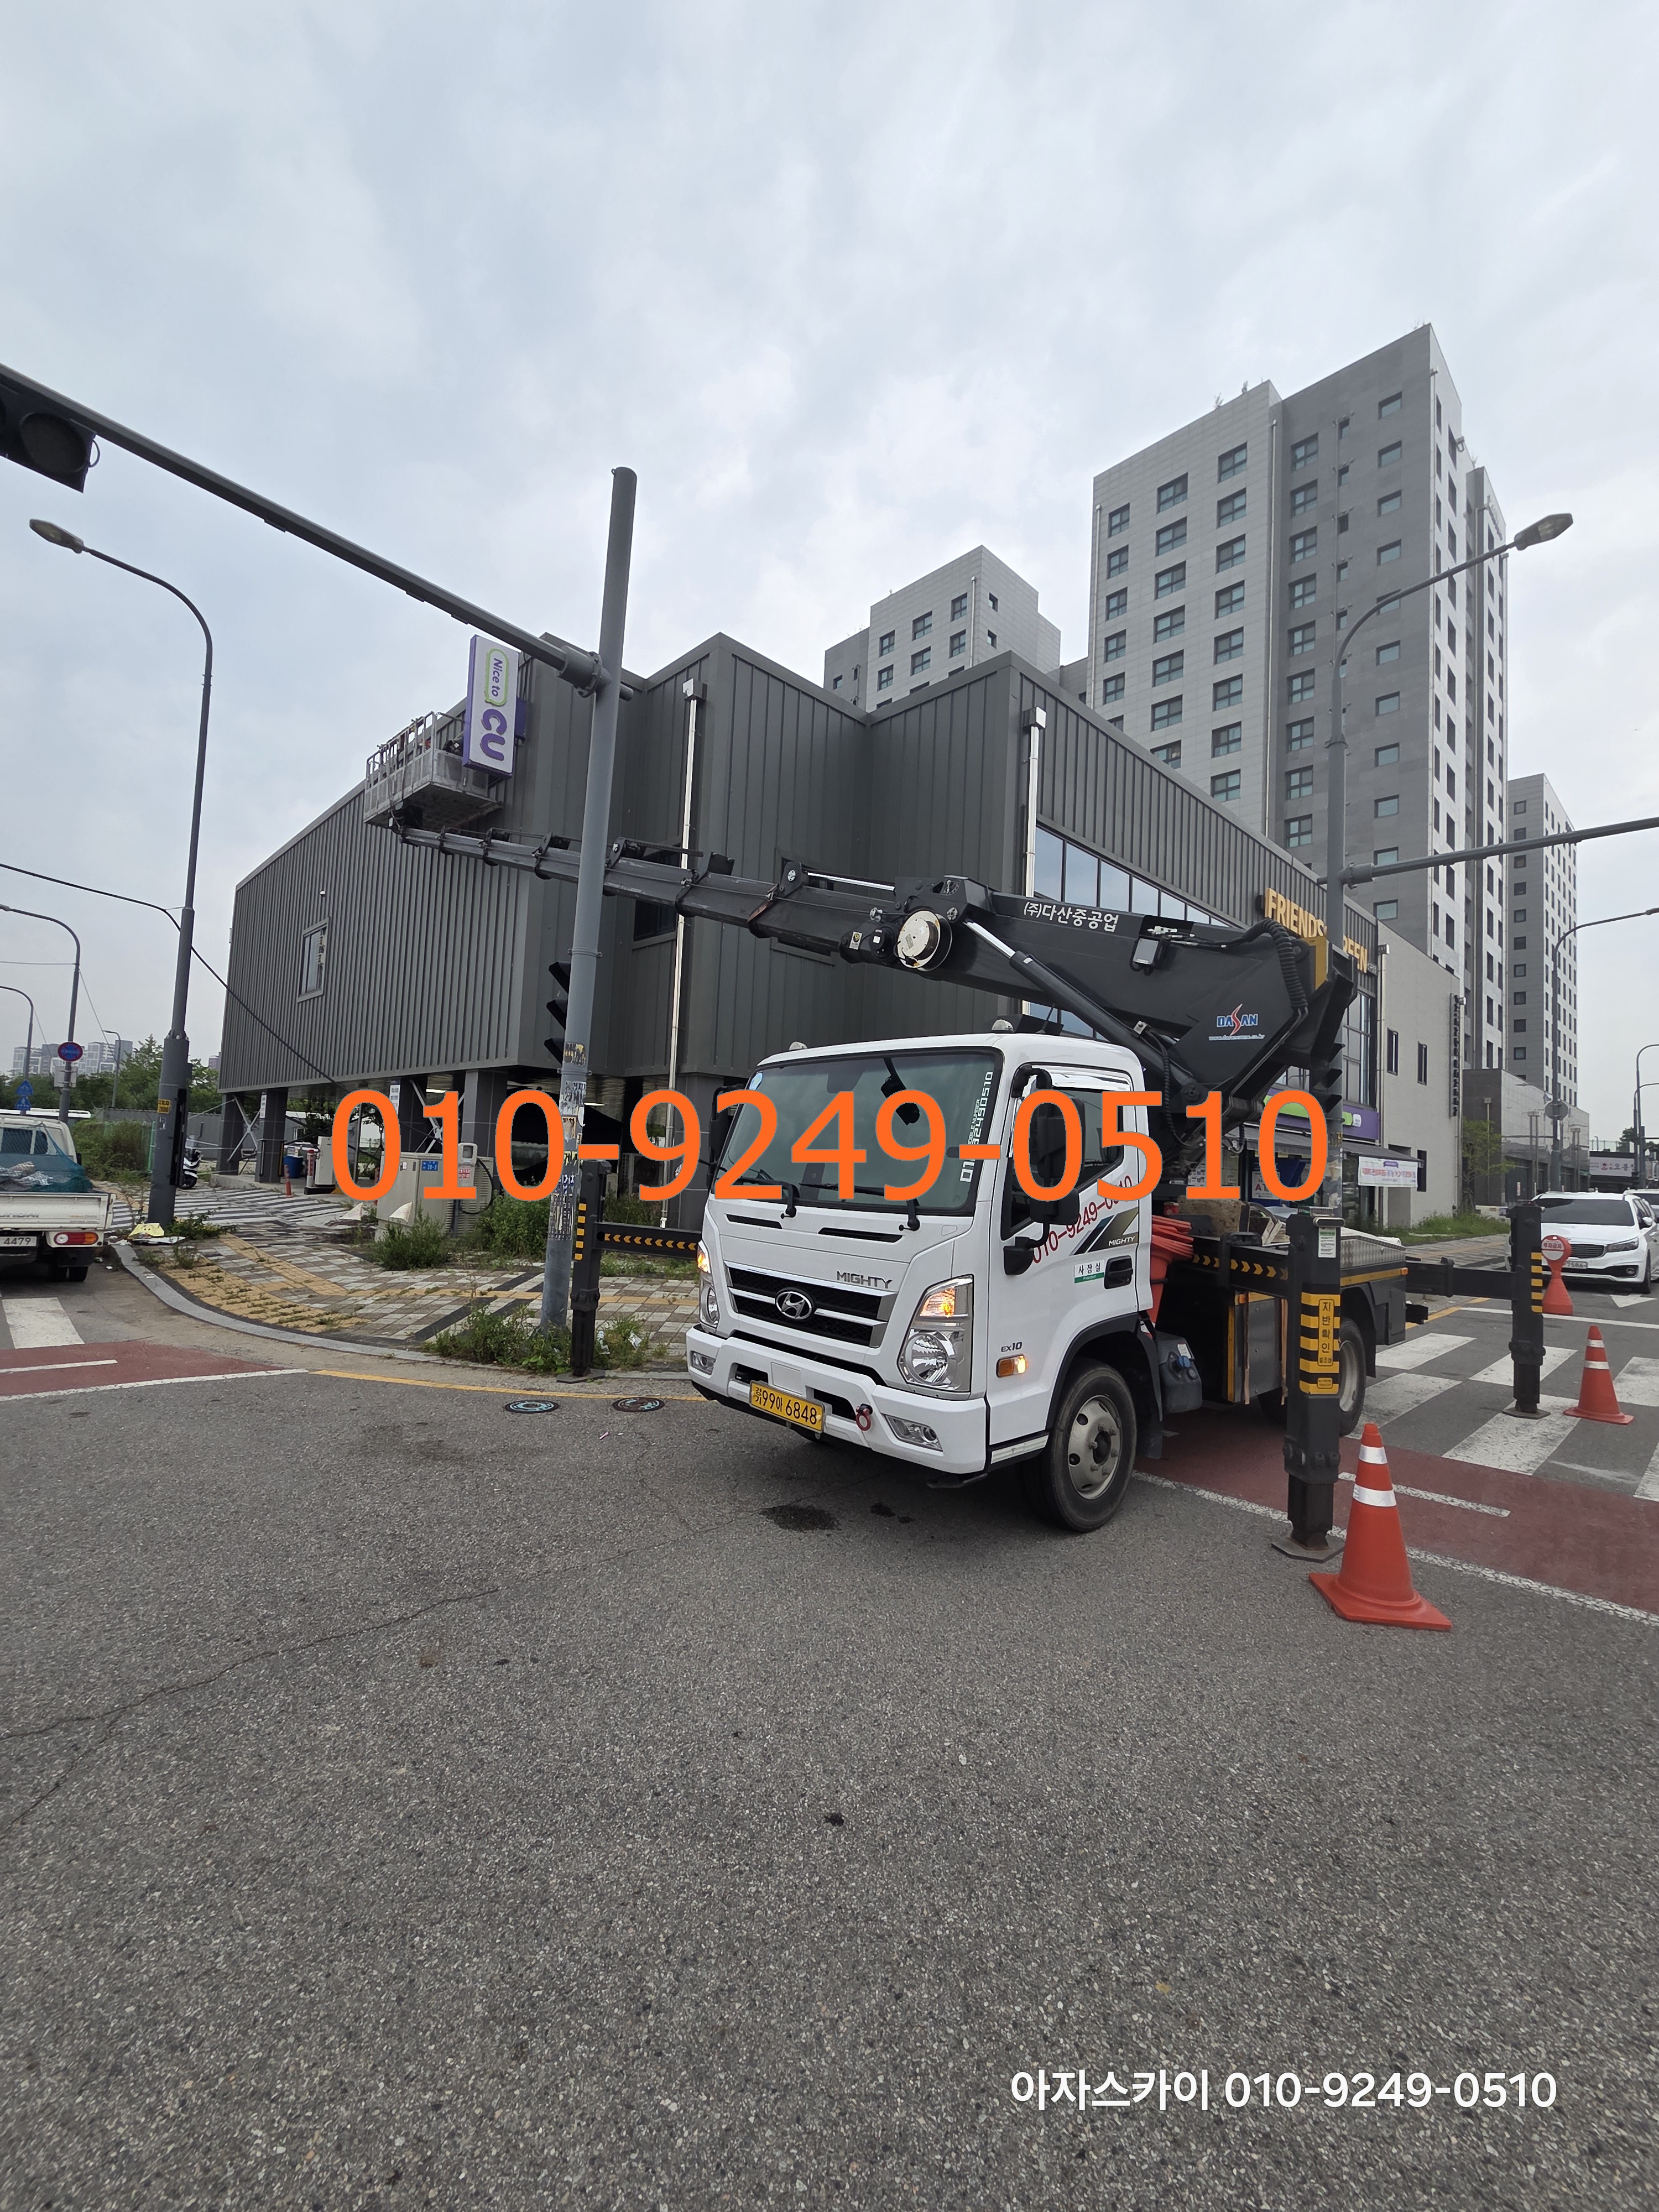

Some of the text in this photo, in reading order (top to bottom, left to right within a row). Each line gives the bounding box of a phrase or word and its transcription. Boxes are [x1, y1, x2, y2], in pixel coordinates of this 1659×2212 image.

[491, 657, 503, 697] Nice to
[480, 708, 508, 761] CU
[1024, 901, 1119, 932] (주)다산중공업
[1217, 1003, 1259, 1036] DASAN
[959, 1072, 993, 1183] 0192490510
[3, 1237, 32, 1245] 4479
[1108, 1236, 1136, 1246] MIGHTY
[837, 1271, 893, 1289] MIGHTY
[1078, 1262, 1100, 1275] 사장실
[1001, 1342, 1022, 1353] EX10
[762, 1390, 783, 1412] 99아
[785, 1399, 817, 1425] 6848
